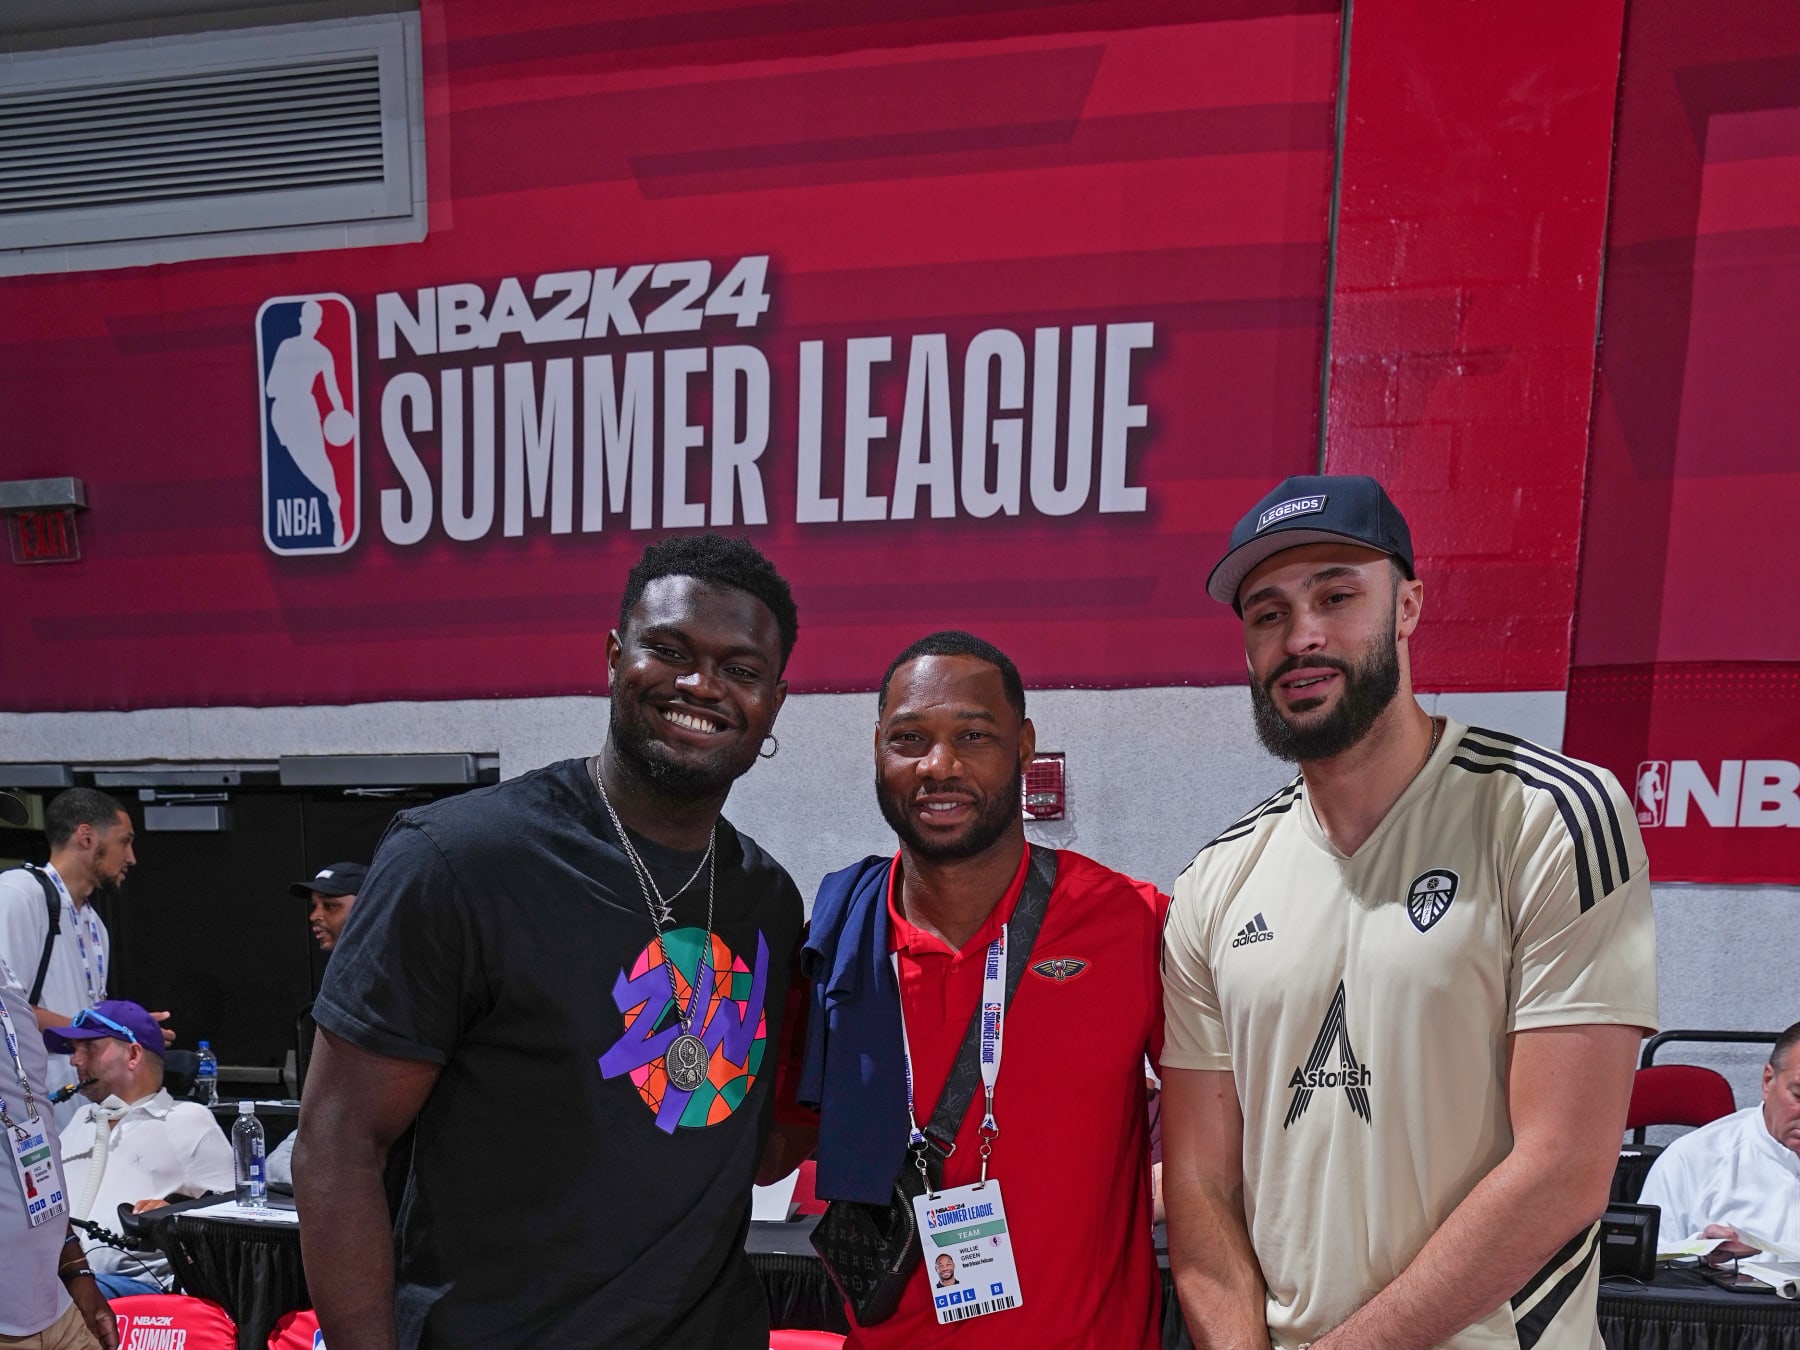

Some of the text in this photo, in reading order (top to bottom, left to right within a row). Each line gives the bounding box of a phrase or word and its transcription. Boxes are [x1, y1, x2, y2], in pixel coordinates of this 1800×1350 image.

[376, 254, 771, 359] NBA2K24
[380, 321, 1155, 545] SUMMER LEAGUE
[276, 497, 322, 537] NBA
[1262, 499, 1319, 525] LEGENDS
[18, 511, 69, 558] EXIT
[1664, 760, 1800, 828] NB
[1232, 929, 1274, 949] adidas
[937, 1203, 994, 1227] SUMMER LEAGUE
[958, 1229, 981, 1239] TEAM
[961, 1252, 981, 1261] GREEN
[133, 1316, 174, 1326] NBA2K
